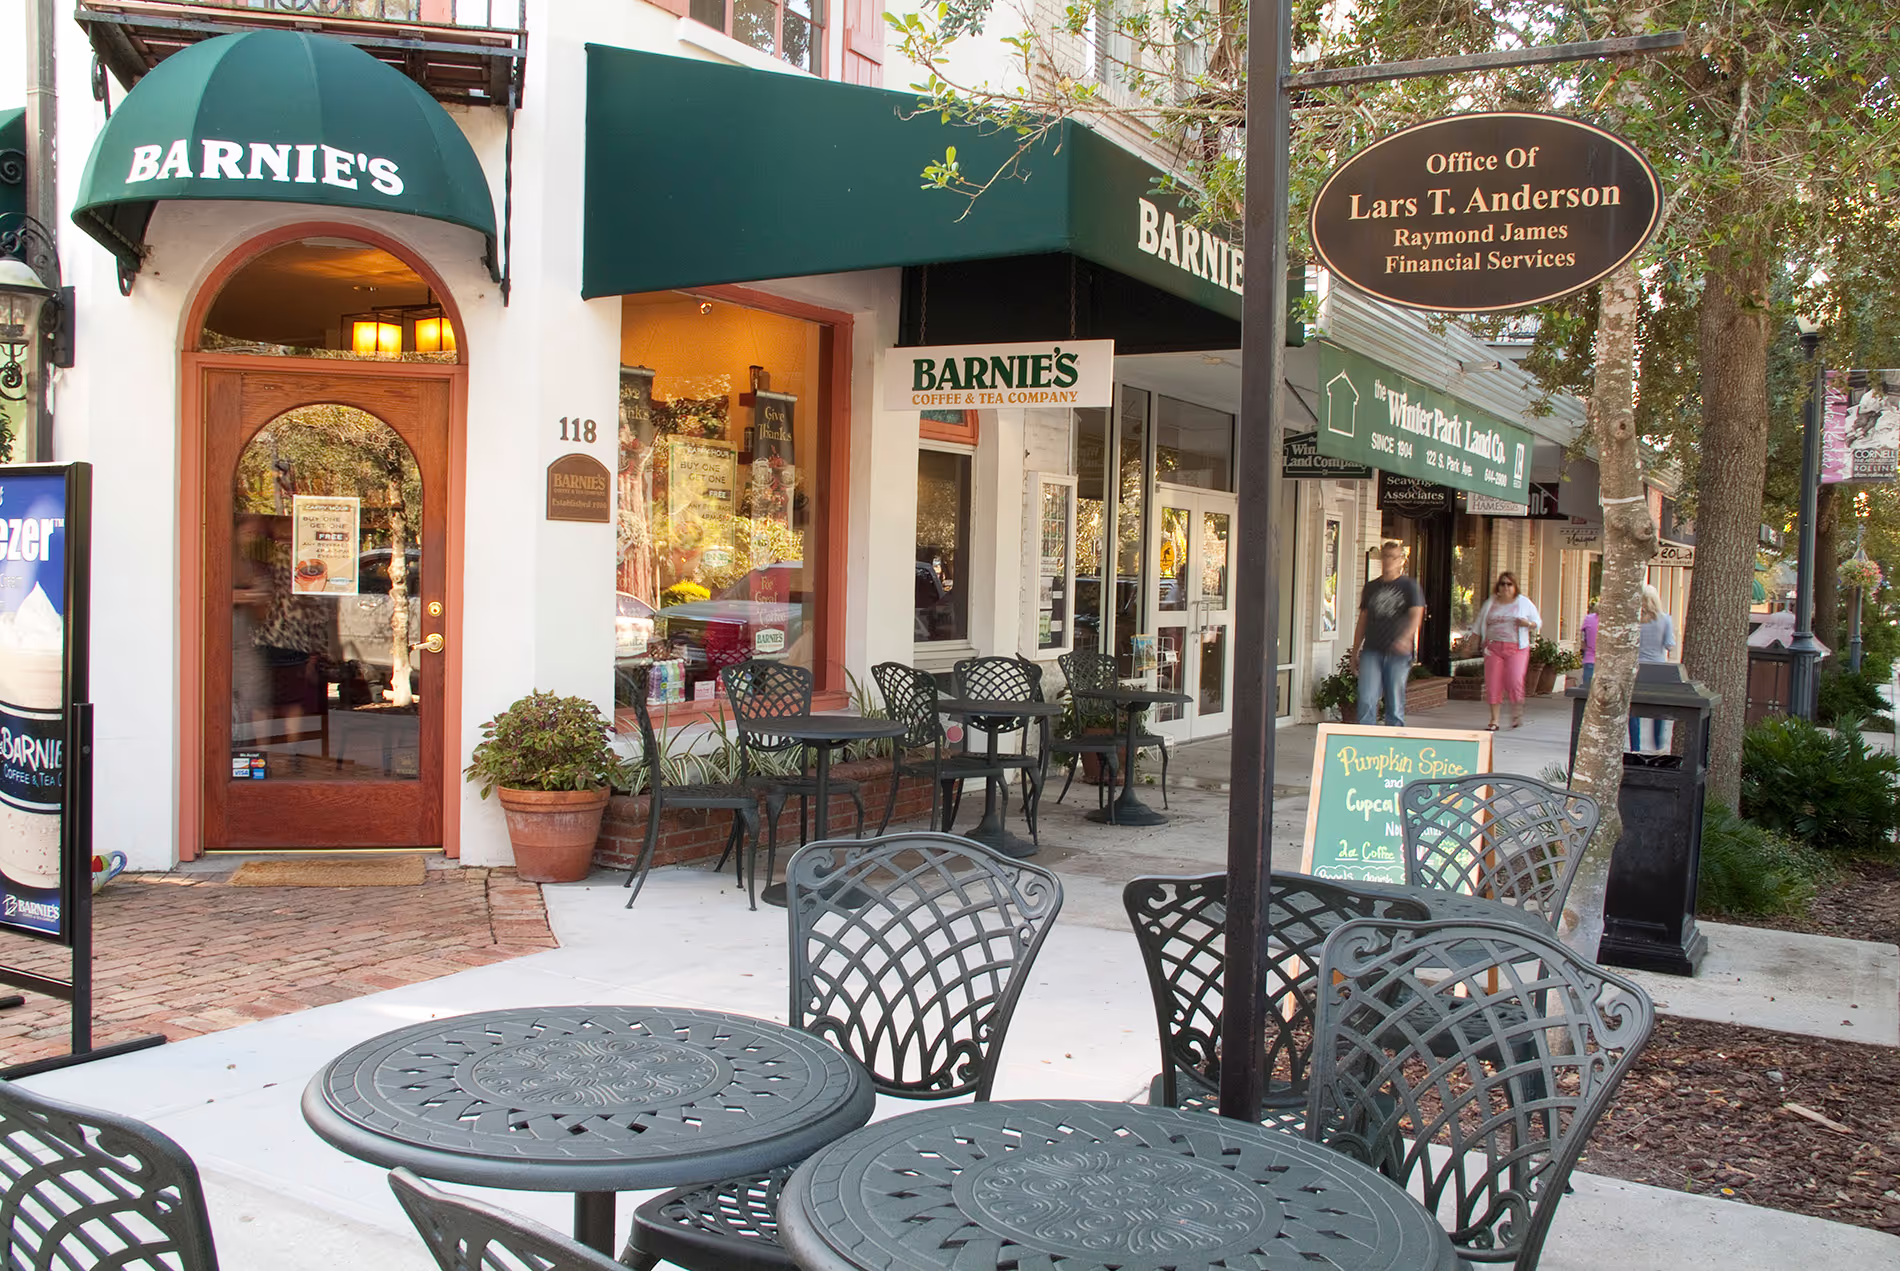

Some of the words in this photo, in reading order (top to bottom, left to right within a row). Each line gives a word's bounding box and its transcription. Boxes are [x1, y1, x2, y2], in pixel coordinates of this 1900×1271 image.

[125, 139, 405, 196] BARNIE'S
[1426, 150, 1498, 175] Office
[1505, 146, 1540, 170] Of
[1348, 193, 1417, 220] Lars
[1427, 188, 1456, 216] T.
[1463, 183, 1622, 215] Anderson
[1394, 225, 1494, 250] Raymond
[1500, 222, 1569, 244] James
[1384, 252, 1481, 275] Financial
[1486, 250, 1576, 272] Services
[912, 347, 1079, 391] BARNIE'S
[912, 393, 961, 405] COFFEE
[965, 393, 975, 404] &
[979, 392, 1005, 404] TEA
[1008, 391, 1079, 404] COMPANY
[764, 406, 785, 425] Give
[1374, 379, 1387, 401] the
[1387, 389, 1434, 438] Winter
[1432, 408, 1462, 448] Park
[1464, 420, 1492, 460] Land
[1491, 433, 1506, 465] Co.
[559, 416, 597, 444] 118
[757, 423, 793, 442] Thanks
[1291, 443, 1318, 455] Win
[1371, 432, 1395, 454] SINCE
[1397, 440, 1413, 459] 1904
[1426, 450, 1437, 467] 122
[1446, 456, 1460, 473] Park
[1854, 449, 1895, 459] CORNELL
[680, 461, 699, 470] BUY
[702, 463, 721, 473] ONE
[1282, 455, 1312, 467] Land
[553, 472, 606, 491] BARNIE'S
[688, 473, 706, 482] GET
[708, 475, 726, 484] ONE
[709, 490, 727, 499] FREE
[1384, 490, 1445, 501] Associates
[755, 591, 778, 605] Great
[1337, 746, 1412, 778] Pumpkin
[1418, 747, 1468, 779] Spice
[4, 763, 30, 784] COFFEE
[33, 776, 39, 788] &
[39, 772, 56, 787] TEA
[1384, 775, 1404, 788] and
[1362, 841, 1395, 860] Coffee
